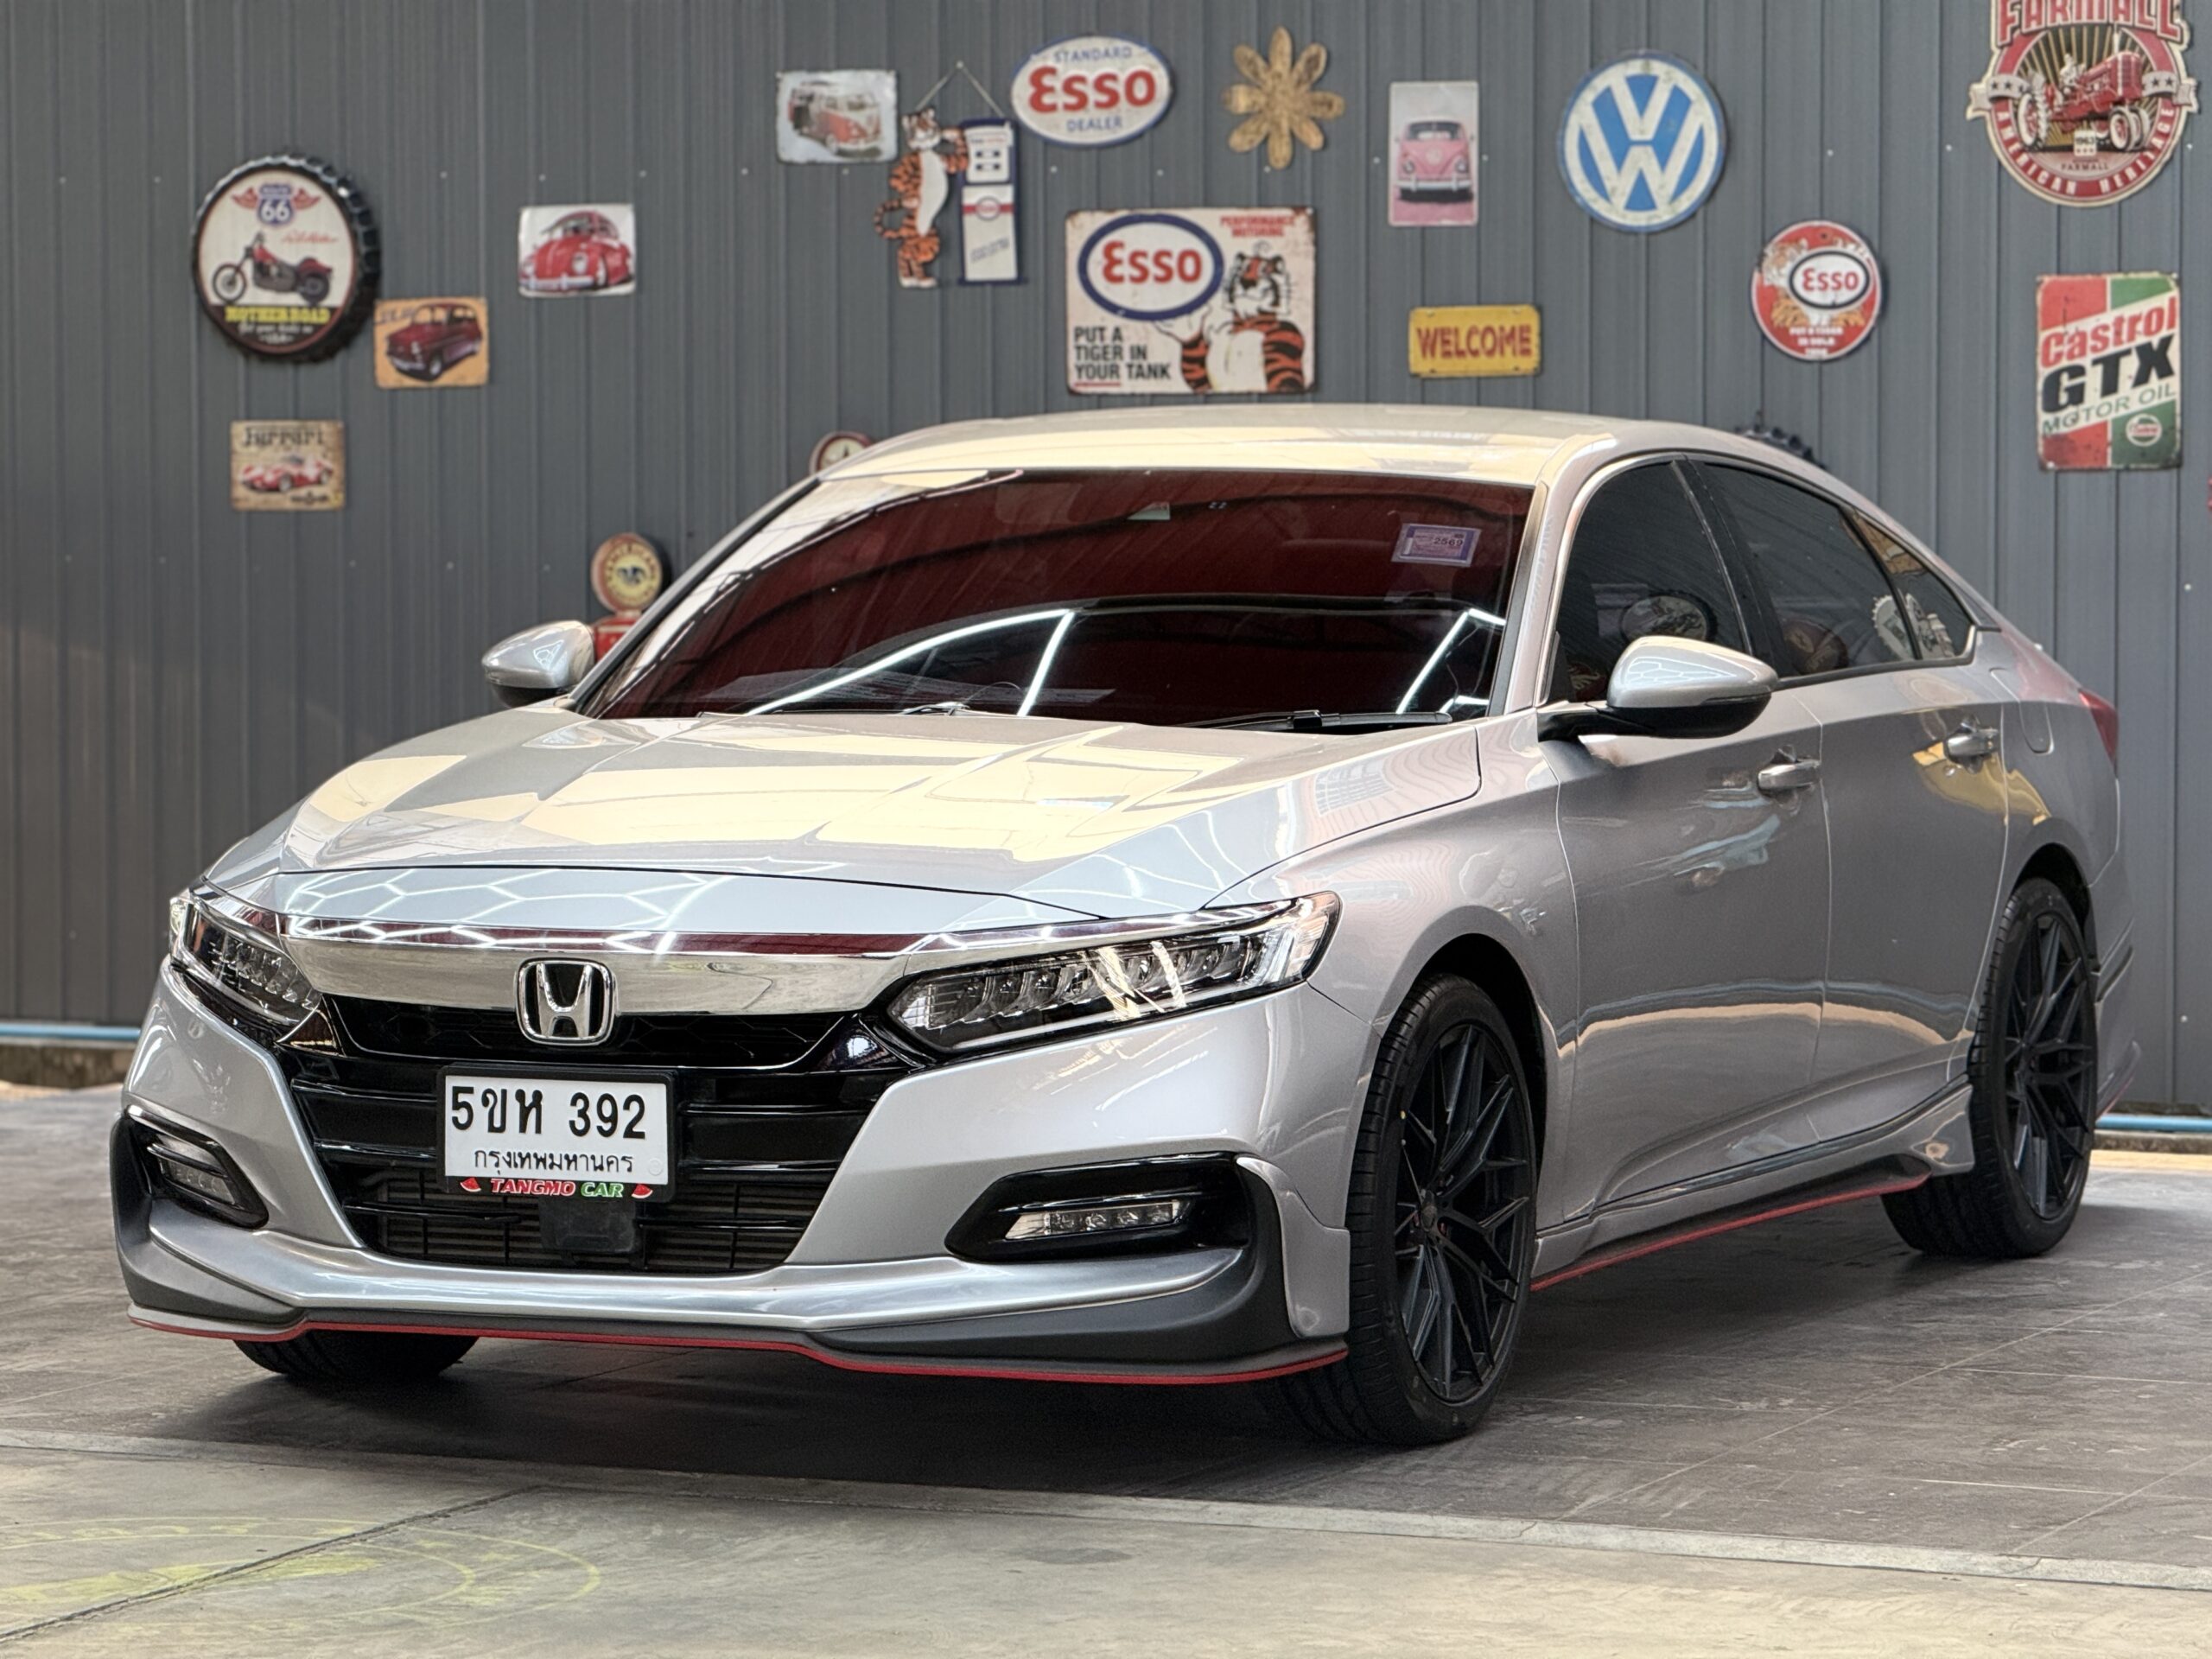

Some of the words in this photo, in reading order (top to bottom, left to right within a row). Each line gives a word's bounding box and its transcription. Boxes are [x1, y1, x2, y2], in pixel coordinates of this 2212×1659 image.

[1053, 46, 1133, 63] STANDARD
[1066, 116, 1123, 132] DEALER
[1997, 110, 2077, 195] AMERICAN
[2099, 107, 2175, 194] HERITAGE
[260, 199, 291, 222] 66
[1074, 326, 1107, 343] PUT
[1110, 326, 1124, 343] A
[1416, 324, 1533, 359] WELCOME
[2040, 296, 2177, 369] Castrol
[1074, 345, 1123, 361] TIGER
[1129, 344, 1147, 361] IN
[1074, 363, 1121, 380] YOUR
[1125, 363, 1172, 380] TANK
[2042, 333, 2176, 415] GTX
[2043, 396, 2131, 434] MOTOR
[2139, 382, 2177, 405] OIL
[450, 1085, 544, 1135] 5ขห
[568, 1091, 646, 1140] 392
[474, 1149, 633, 1175] กรุงเทพมหานคร
[490, 1177, 576, 1197] TANGMO
[580, 1181, 625, 1198] CAR
